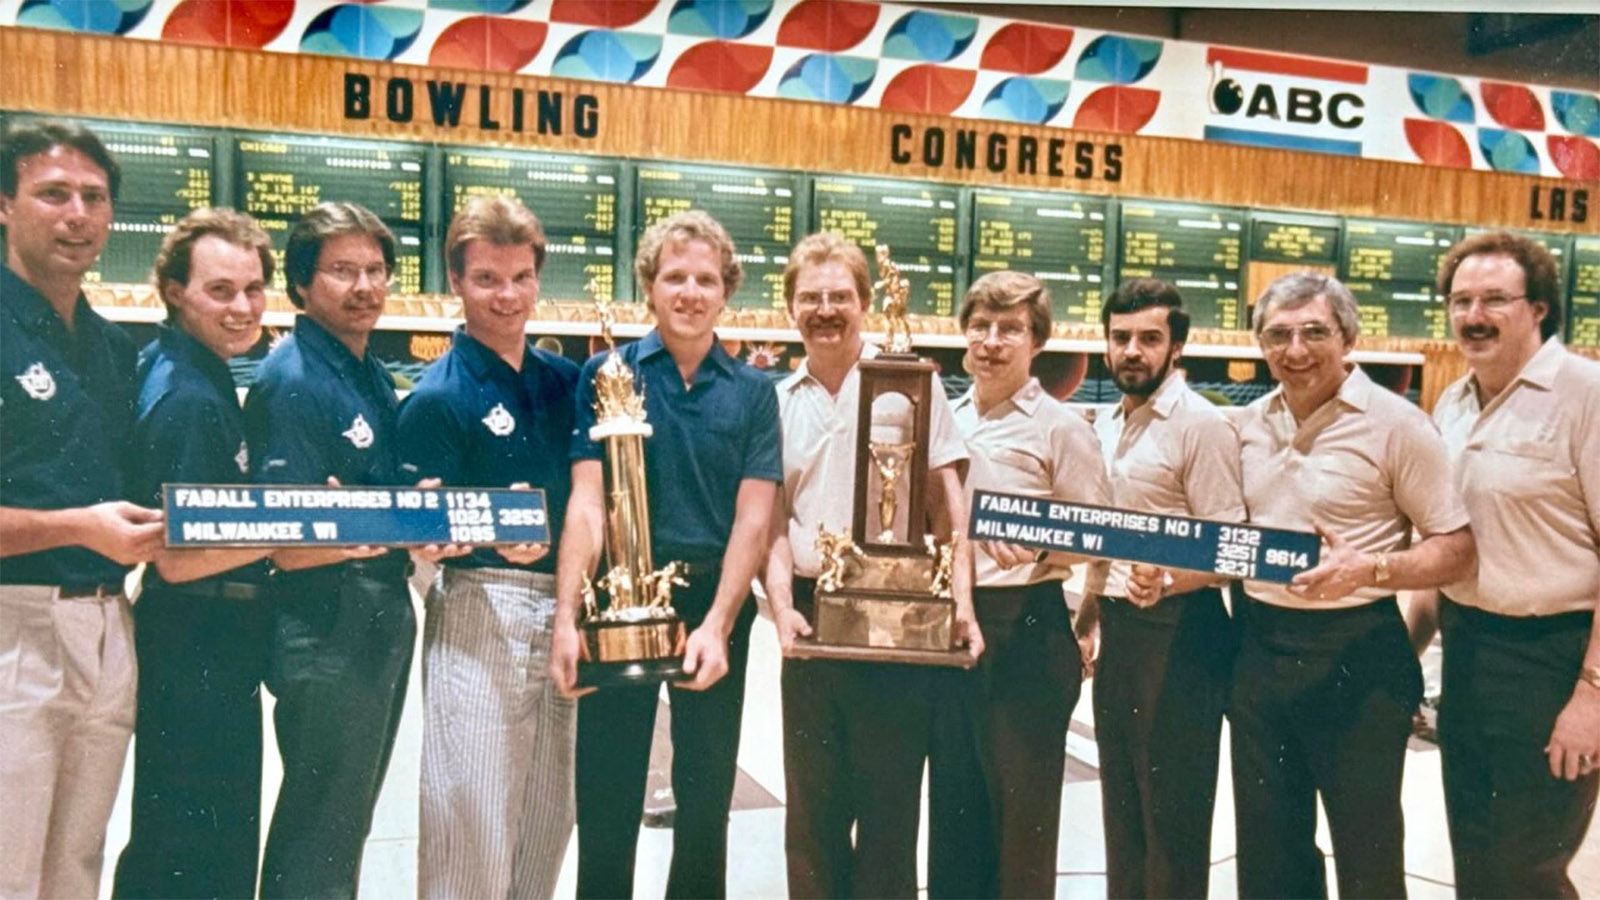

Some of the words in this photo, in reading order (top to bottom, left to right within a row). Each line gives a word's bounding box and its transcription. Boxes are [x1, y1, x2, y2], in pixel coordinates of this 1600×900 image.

[344, 72, 600, 139] BOWLING
[1245, 83, 1366, 130] ABC
[239, 141, 288, 154] CHICAGO
[890, 123, 1124, 182] CONGRESS
[1530, 184, 1589, 223] LAS
[175, 489, 256, 508] FABALL
[263, 490, 393, 509] ENTERPRISES
[396, 491, 424, 509] NO
[425, 491, 439, 509] 2
[446, 492, 491, 510] 1134
[447, 509, 494, 526] 1024
[498, 509, 545, 526] 3253
[979, 495, 1042, 518] FABALL
[1049, 504, 1160, 533] ENTERPRISES
[1165, 521, 1192, 538] NO
[1193, 523, 1202, 539] 1
[1218, 526, 1262, 547] 3132
[183, 522, 304, 541] MILWAUKEE
[312, 522, 338, 540] WI
[450, 525, 496, 542] 1095
[975, 519, 1074, 547] MILWAUKEE
[1082, 532, 1104, 551] WI
[1216, 543, 1258, 562] 3251
[1265, 548, 1309, 569] 9614
[1214, 558, 1257, 578] 3231
